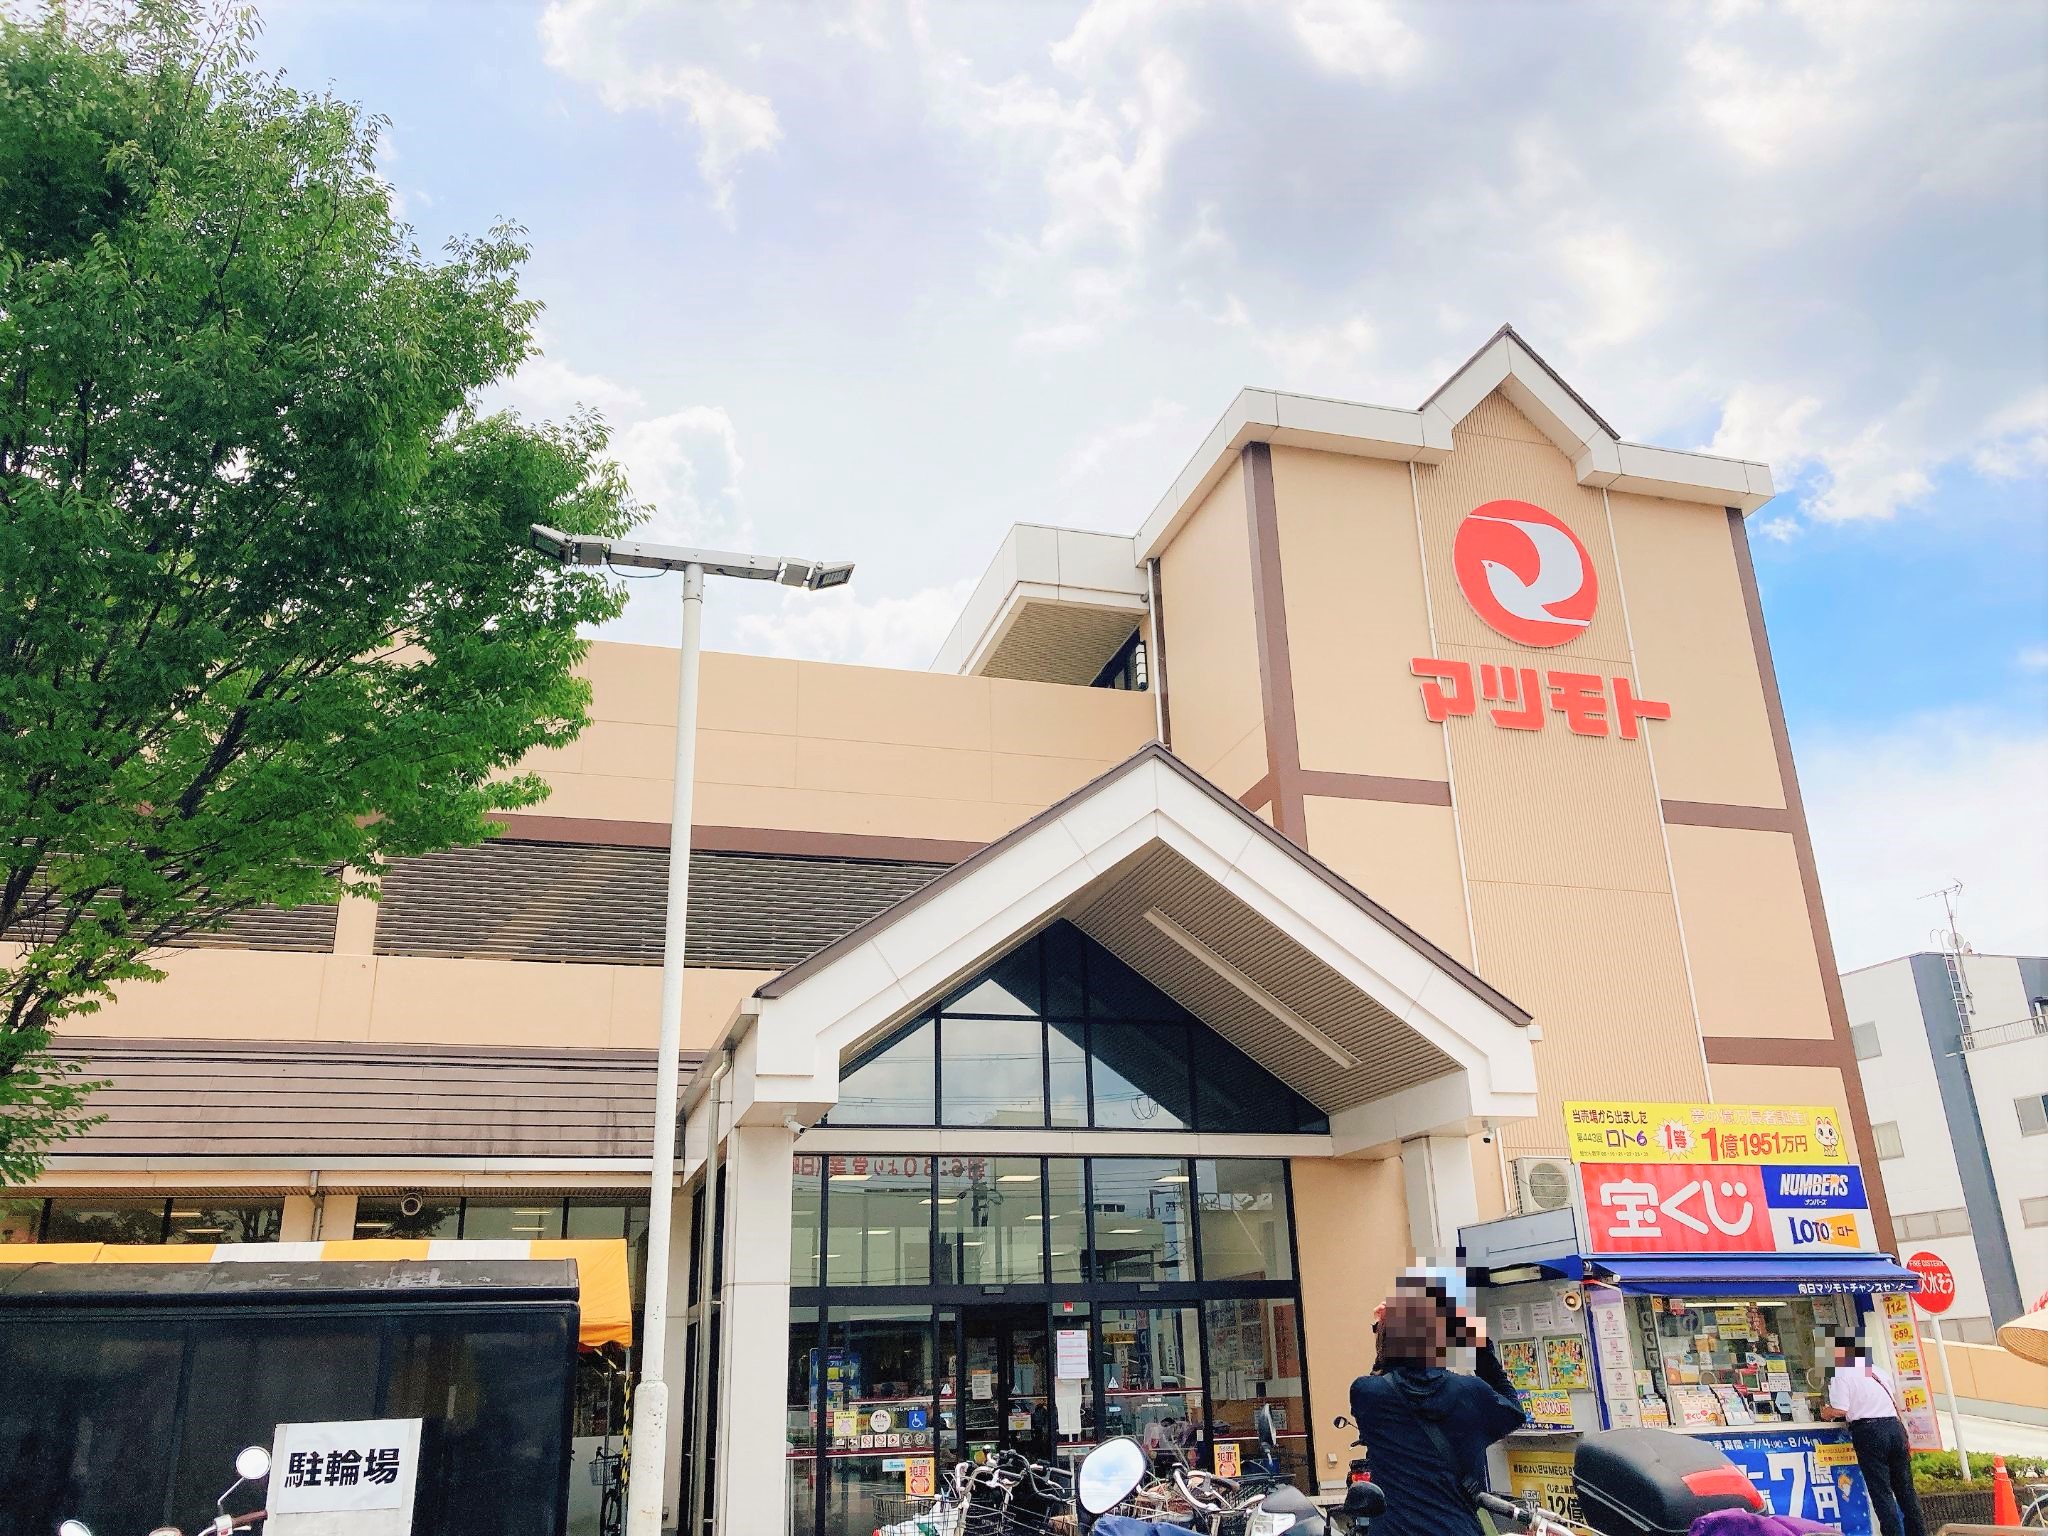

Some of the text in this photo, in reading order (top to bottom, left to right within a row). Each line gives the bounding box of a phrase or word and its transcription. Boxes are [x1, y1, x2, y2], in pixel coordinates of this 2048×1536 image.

[1410, 657, 1672, 740] マツモト
[1572, 1109, 1648, 1124] 当売場から出ました
[1605, 1129, 1648, 1149] ロト6
[1700, 1127, 1809, 1161] 1億1951万円
[1780, 1173, 1849, 1196] NUMBERS
[1600, 1178, 1755, 1238] 宝くじ
[1804, 1198, 1828, 1206] ナンバーズ
[1788, 1216, 1830, 1245] LOTO
[1798, 1281, 1915, 1295] 向日マツモトチャンスセンター
[284, 1448, 400, 1488] 駐輪場
